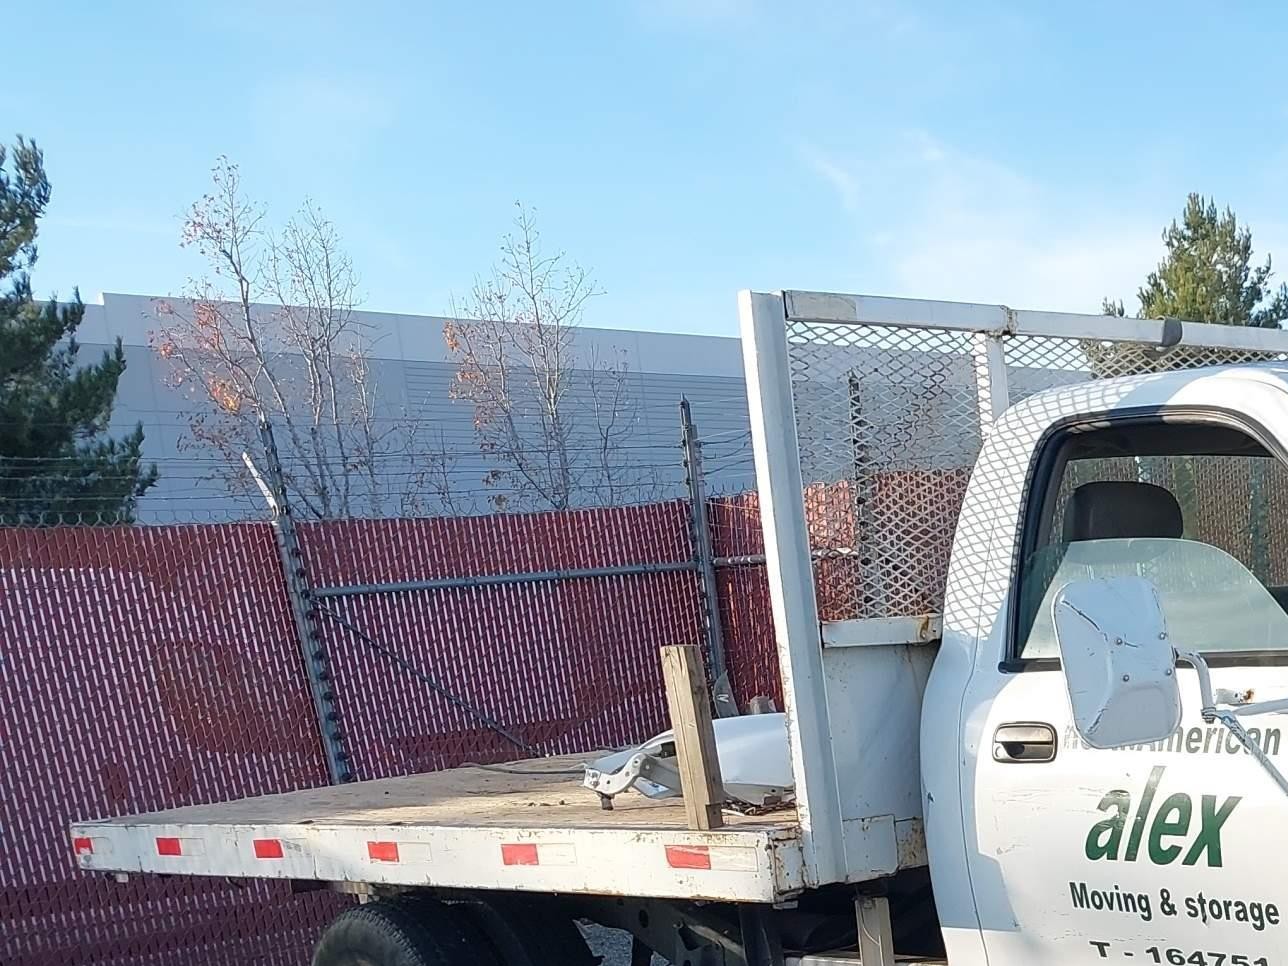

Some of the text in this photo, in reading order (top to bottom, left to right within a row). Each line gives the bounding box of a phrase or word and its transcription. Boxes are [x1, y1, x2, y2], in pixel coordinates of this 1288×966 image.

[1085, 766, 1243, 868] alex
[1069, 882, 1280, 931] Moving & storage
[1089, 940, 1111, 958] T
